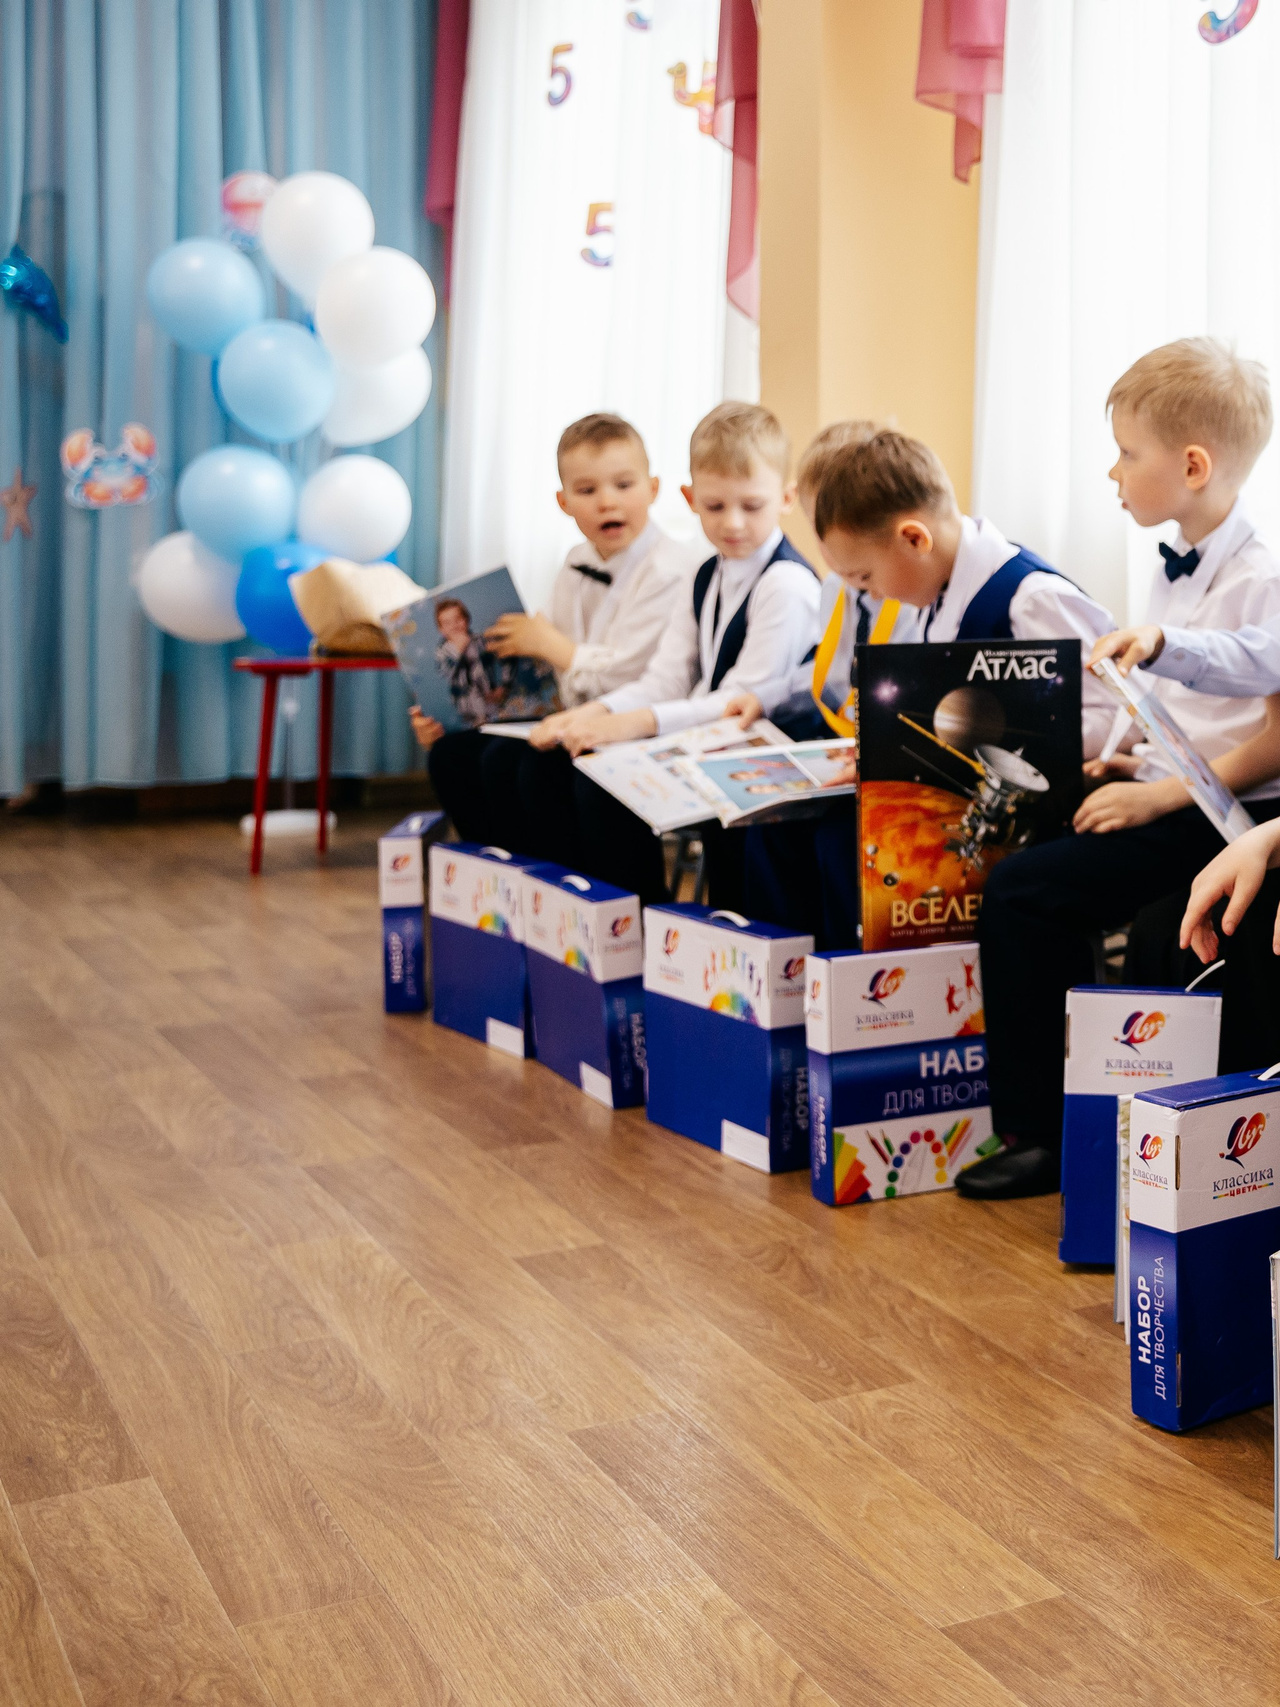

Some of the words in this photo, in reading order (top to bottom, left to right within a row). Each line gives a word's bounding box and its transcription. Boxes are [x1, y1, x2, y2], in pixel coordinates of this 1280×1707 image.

[548, 43, 573, 106] 5
[891, 893, 984, 928] ВСЕЛЕ
[919, 1045, 985, 1078] НАБ
[1104, 1058, 1173, 1071] классика
[881, 1087, 925, 1116] ДЛЯ
[1132, 1167, 1168, 1186] классика
[1213, 1167, 1275, 1193] классика
[1229, 1184, 1258, 1198] ЦВЕТА
[1138, 1275, 1152, 1365] НАБОР
[1153, 1256, 1165, 1360] ТВОРЧЕСТВА
[1154, 1364, 1167, 1401] ДЛЯ
